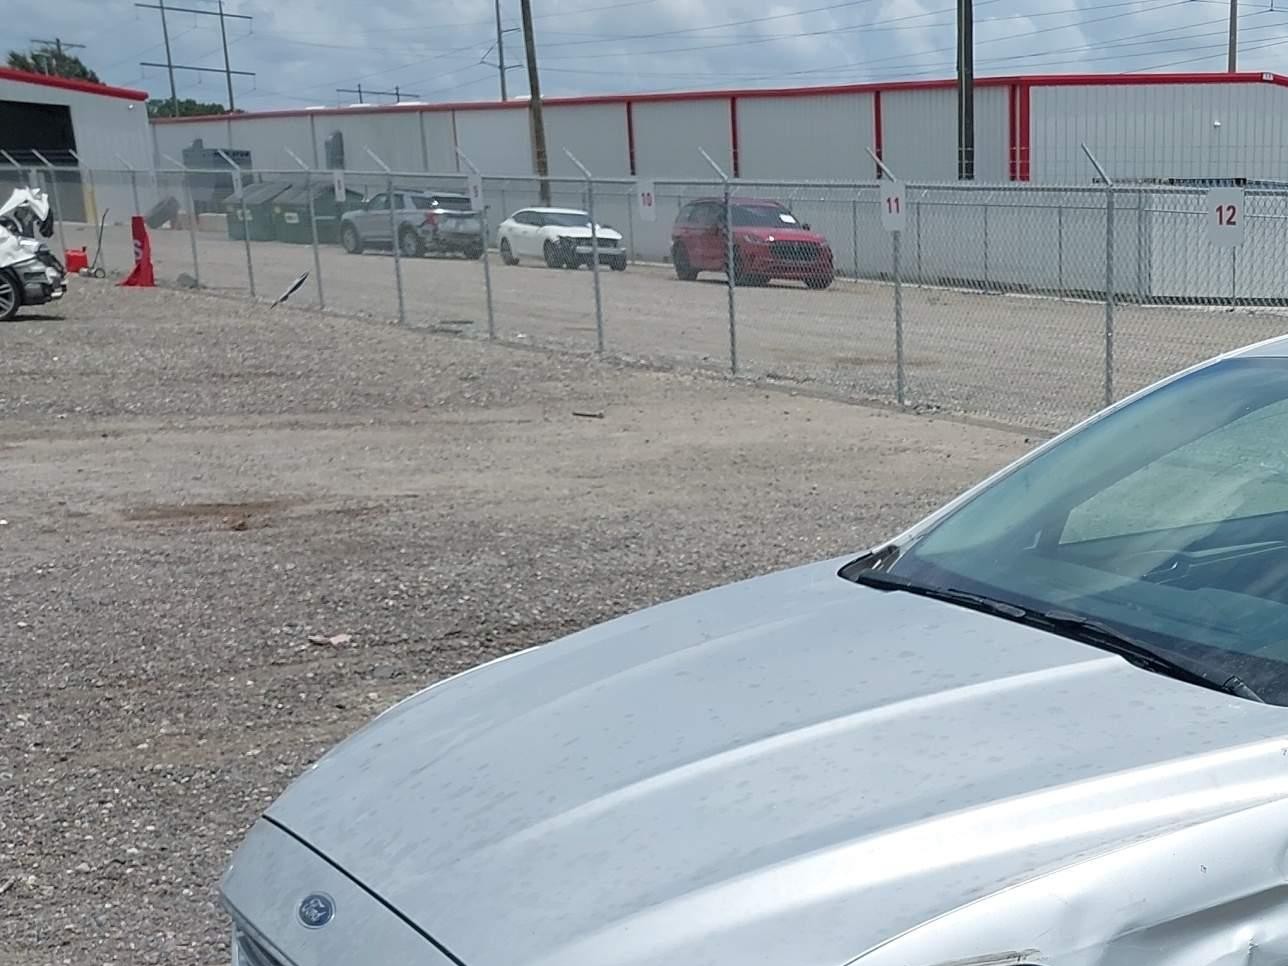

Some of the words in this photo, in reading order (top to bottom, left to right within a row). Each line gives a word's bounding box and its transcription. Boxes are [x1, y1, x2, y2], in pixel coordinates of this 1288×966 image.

[641, 192, 653, 207] 10
[886, 197, 900, 214] 11
[1215, 205, 1237, 226] 12
